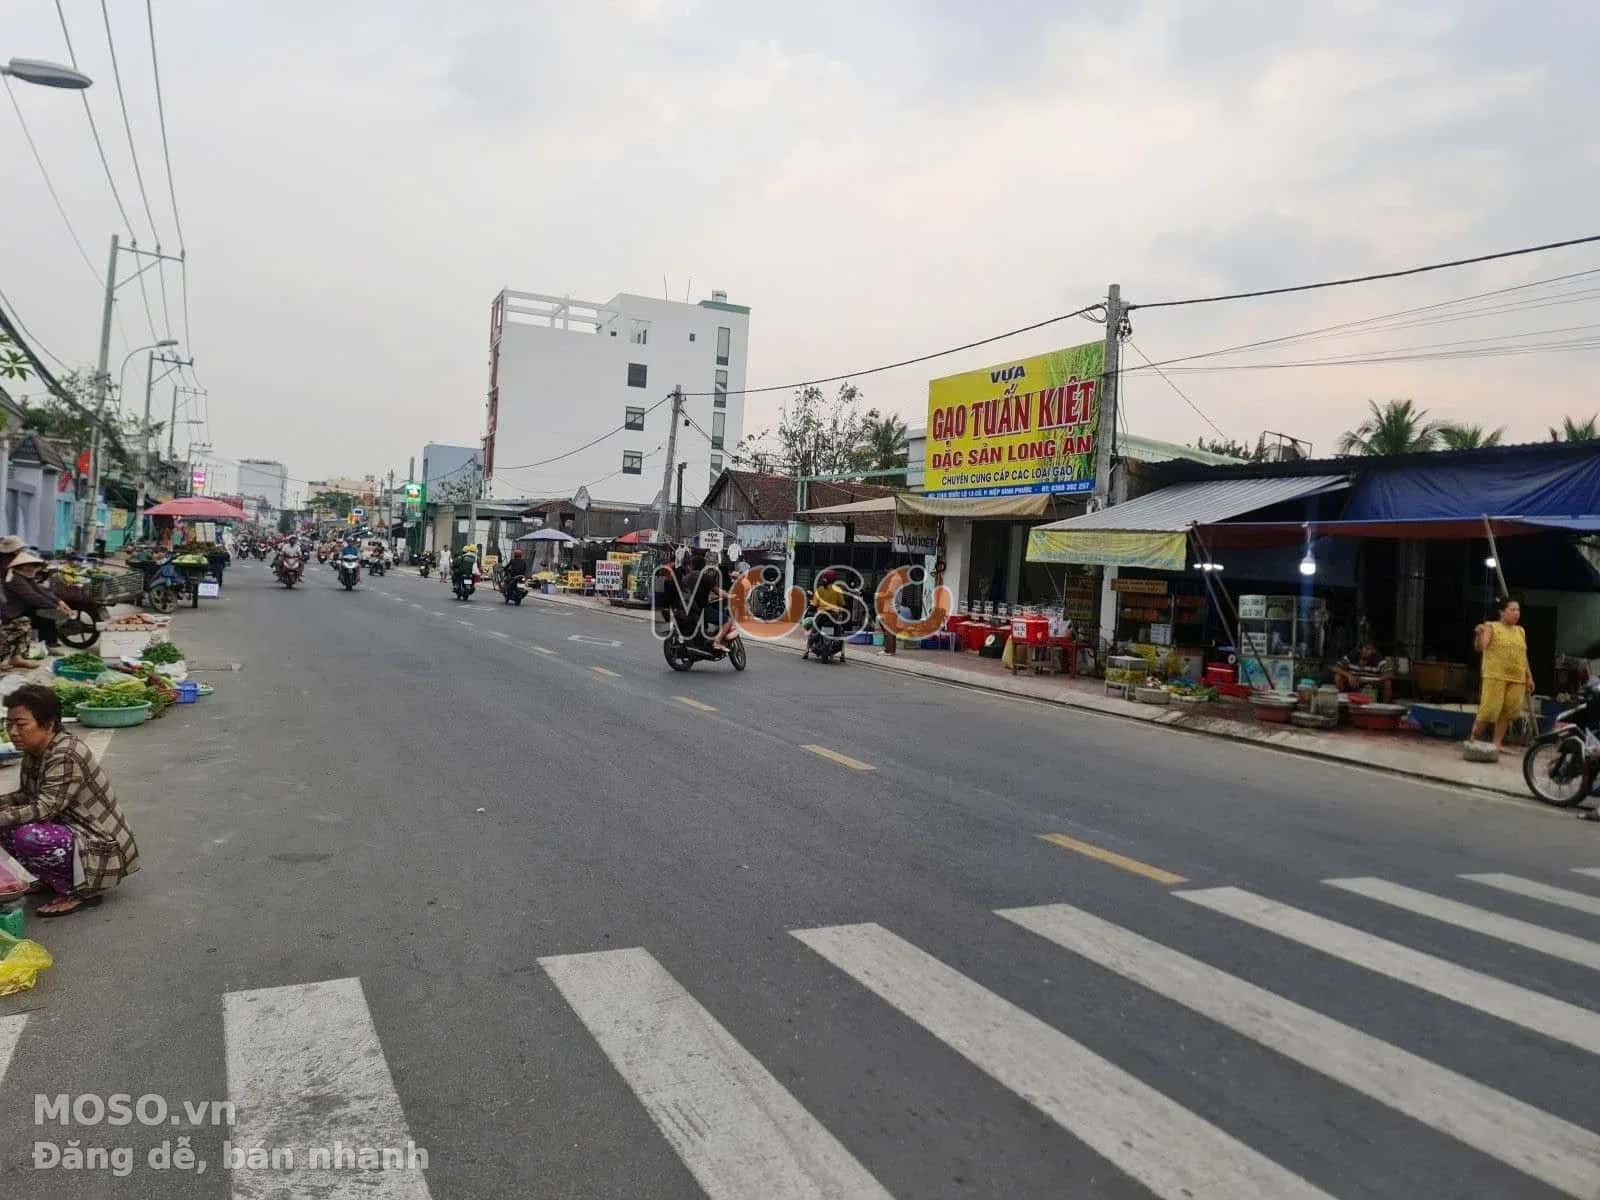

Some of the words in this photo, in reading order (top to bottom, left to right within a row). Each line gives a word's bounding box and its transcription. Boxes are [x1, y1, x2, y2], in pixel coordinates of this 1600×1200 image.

[991, 366, 1025, 384] VỰA
[932, 404, 967, 448] GẠO
[971, 383, 1034, 439] TUẤN
[1037, 375, 1095, 432] KIỆT
[967, 442, 1002, 466] SẢN
[1007, 439, 1056, 462] LONG
[1062, 434, 1093, 456] AN
[942, 474, 968, 486] CHUYÊN
[971, 473, 991, 484] CUNG
[993, 467, 1010, 480] CẤP
[1011, 467, 1030, 480] CÁC
